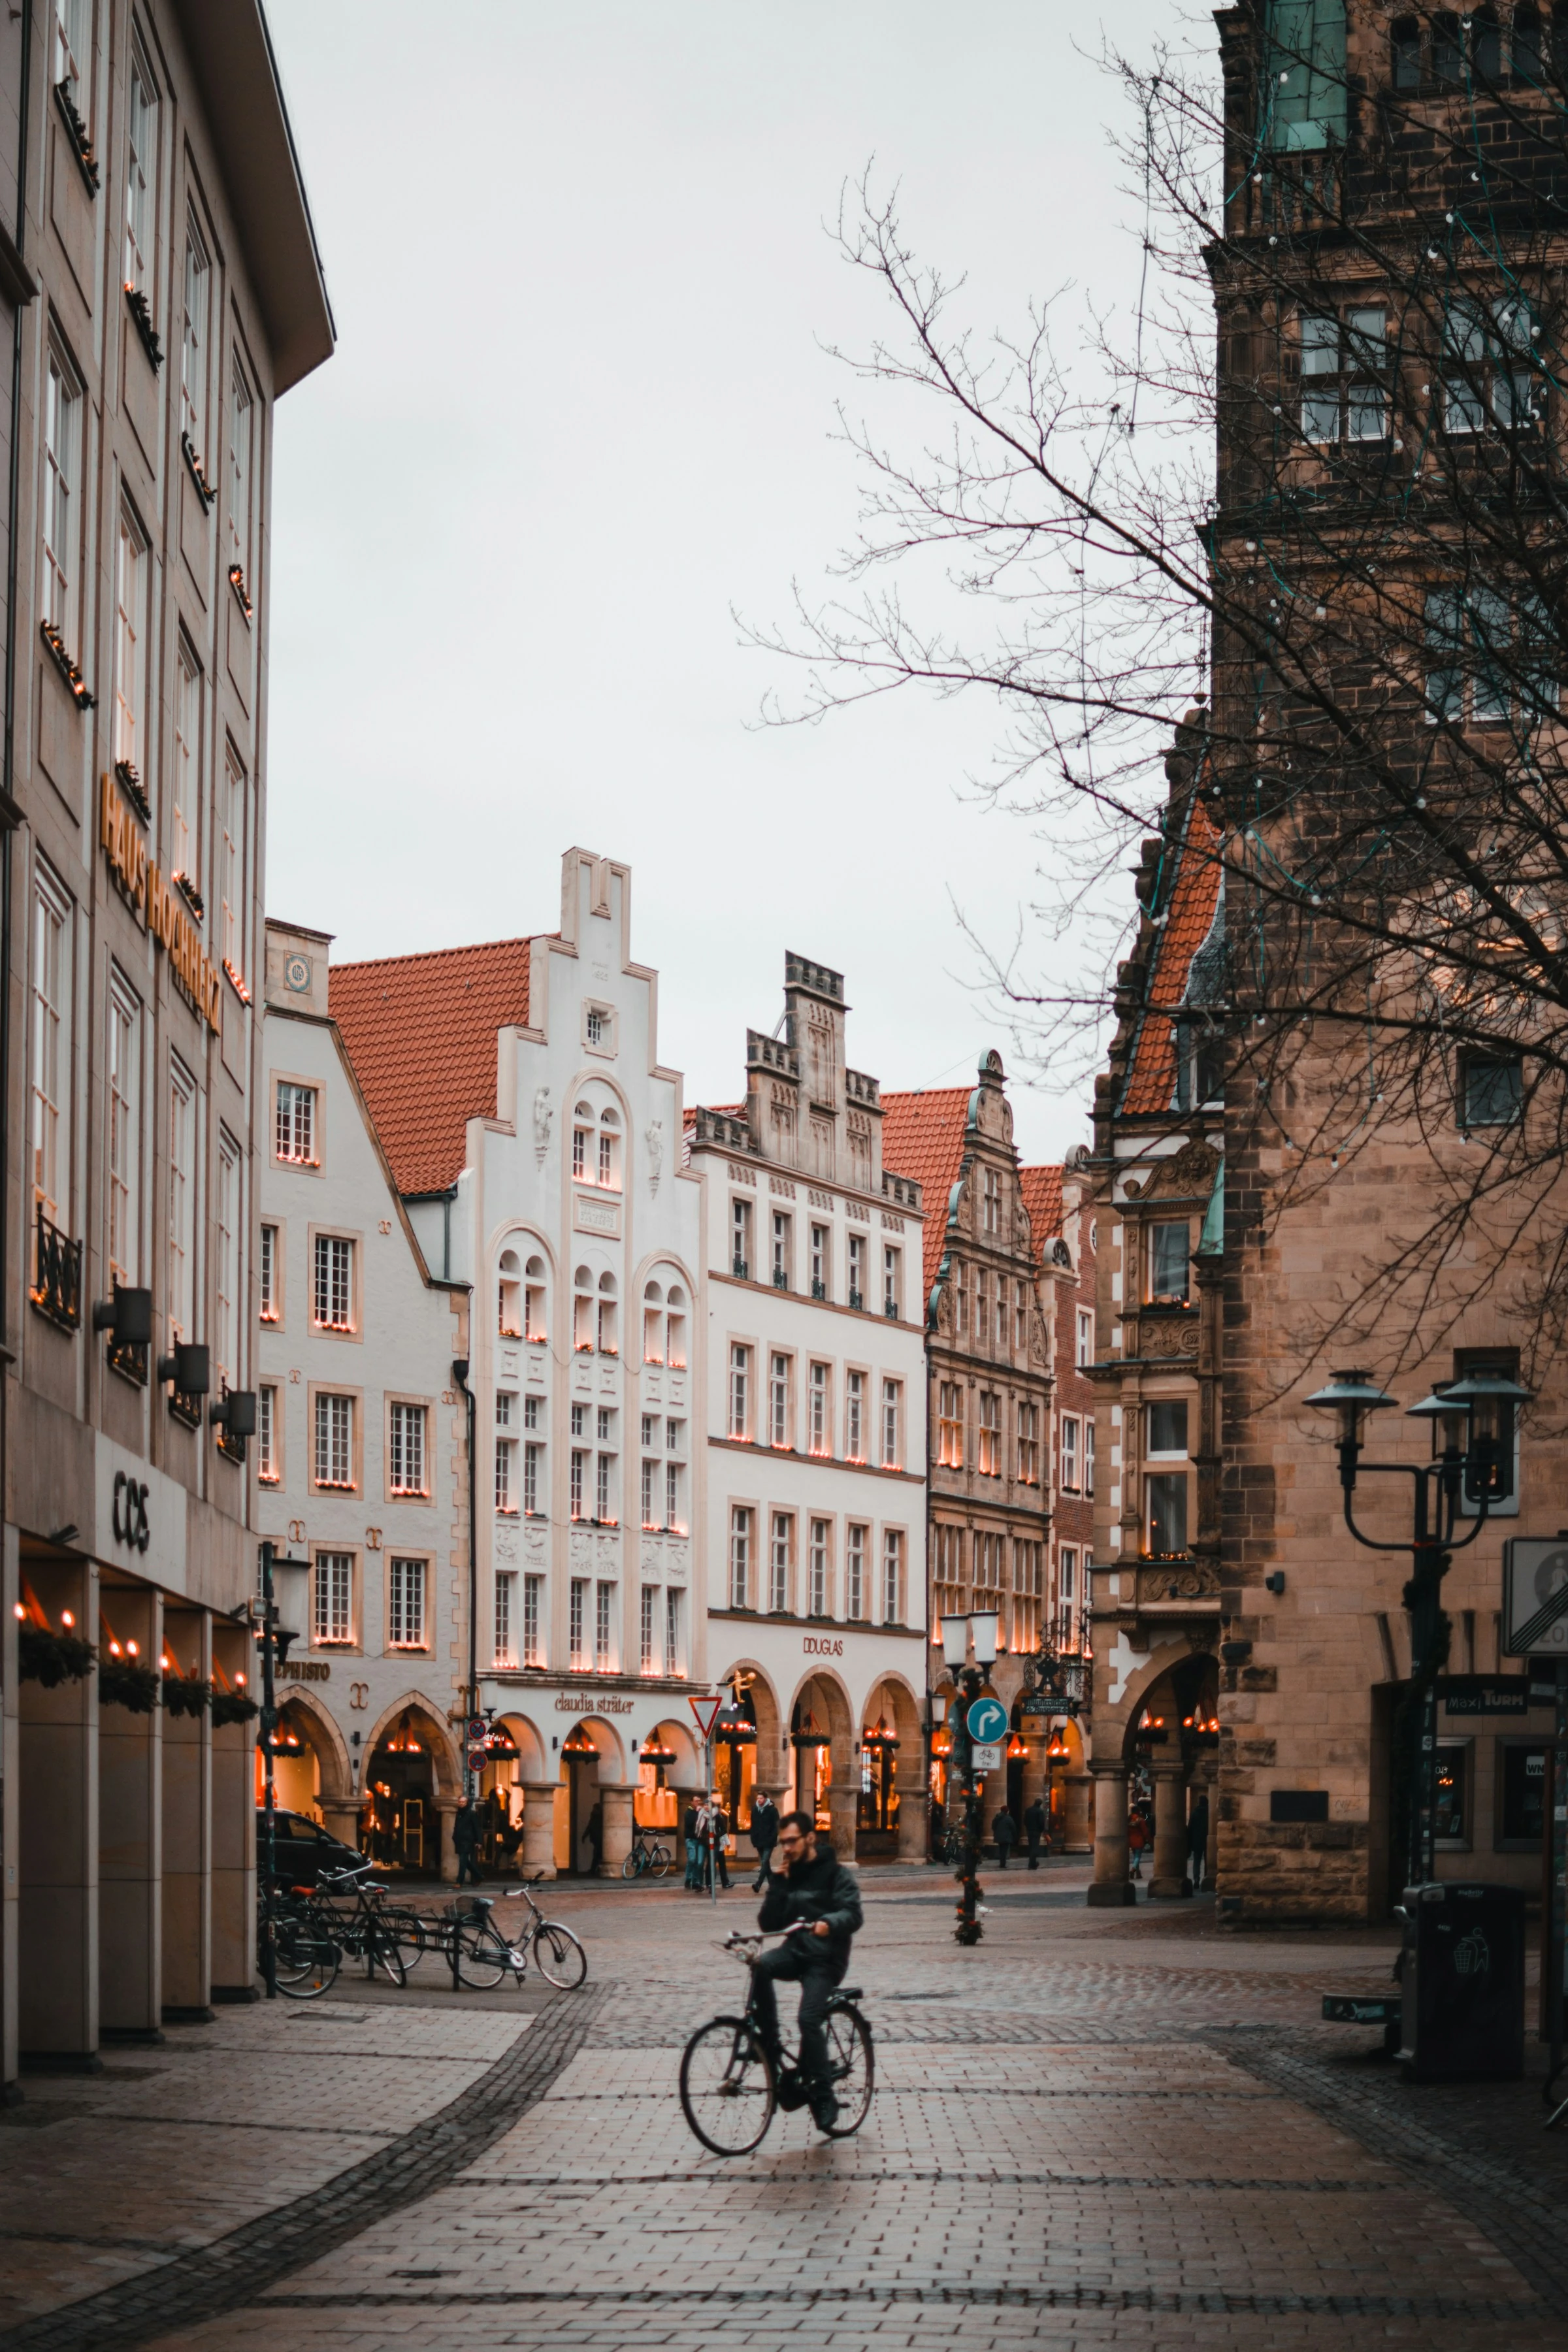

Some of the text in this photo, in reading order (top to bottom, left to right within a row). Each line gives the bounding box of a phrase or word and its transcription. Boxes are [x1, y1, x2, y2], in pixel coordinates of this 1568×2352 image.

[101, 772, 145, 909] HAUS
[114, 1470, 150, 1555] COS
[804, 1637, 843, 1656] DOUGLAS
[555, 1691, 634, 1714] claudia sträter
